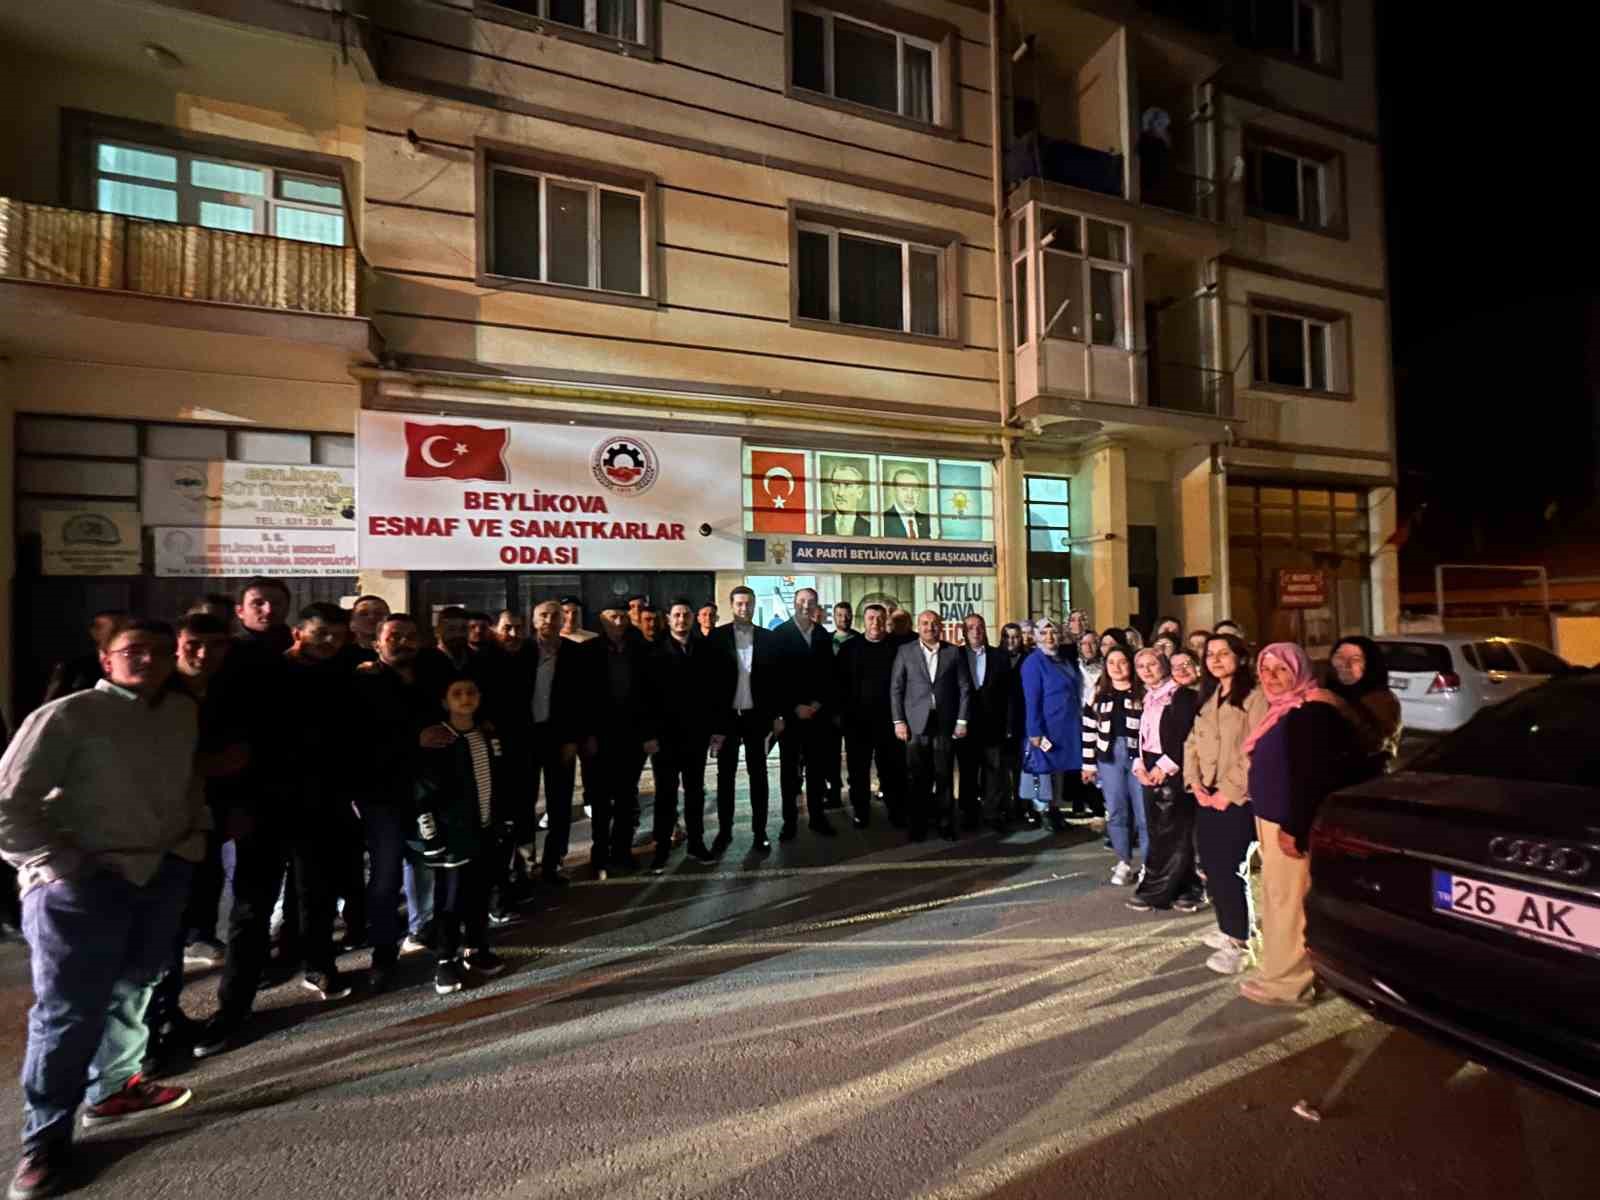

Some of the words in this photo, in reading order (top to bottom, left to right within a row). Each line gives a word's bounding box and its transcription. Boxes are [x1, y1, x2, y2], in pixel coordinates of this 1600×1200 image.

[463, 489, 609, 514] BEYLİKOVA
[368, 515, 460, 537] ESNAF
[467, 518, 503, 538] VE
[510, 519, 686, 541] SANATKARLAR
[499, 545, 580, 565] ODASI
[796, 547, 814, 558] AK
[816, 545, 848, 560] PARTİ
[850, 547, 909, 561] BEYLİKOVA
[911, 548, 932, 564] İLÇE
[933, 582, 983, 602] KUTLU
[1453, 881, 1496, 914] 26
[1516, 896, 1576, 938] AK
